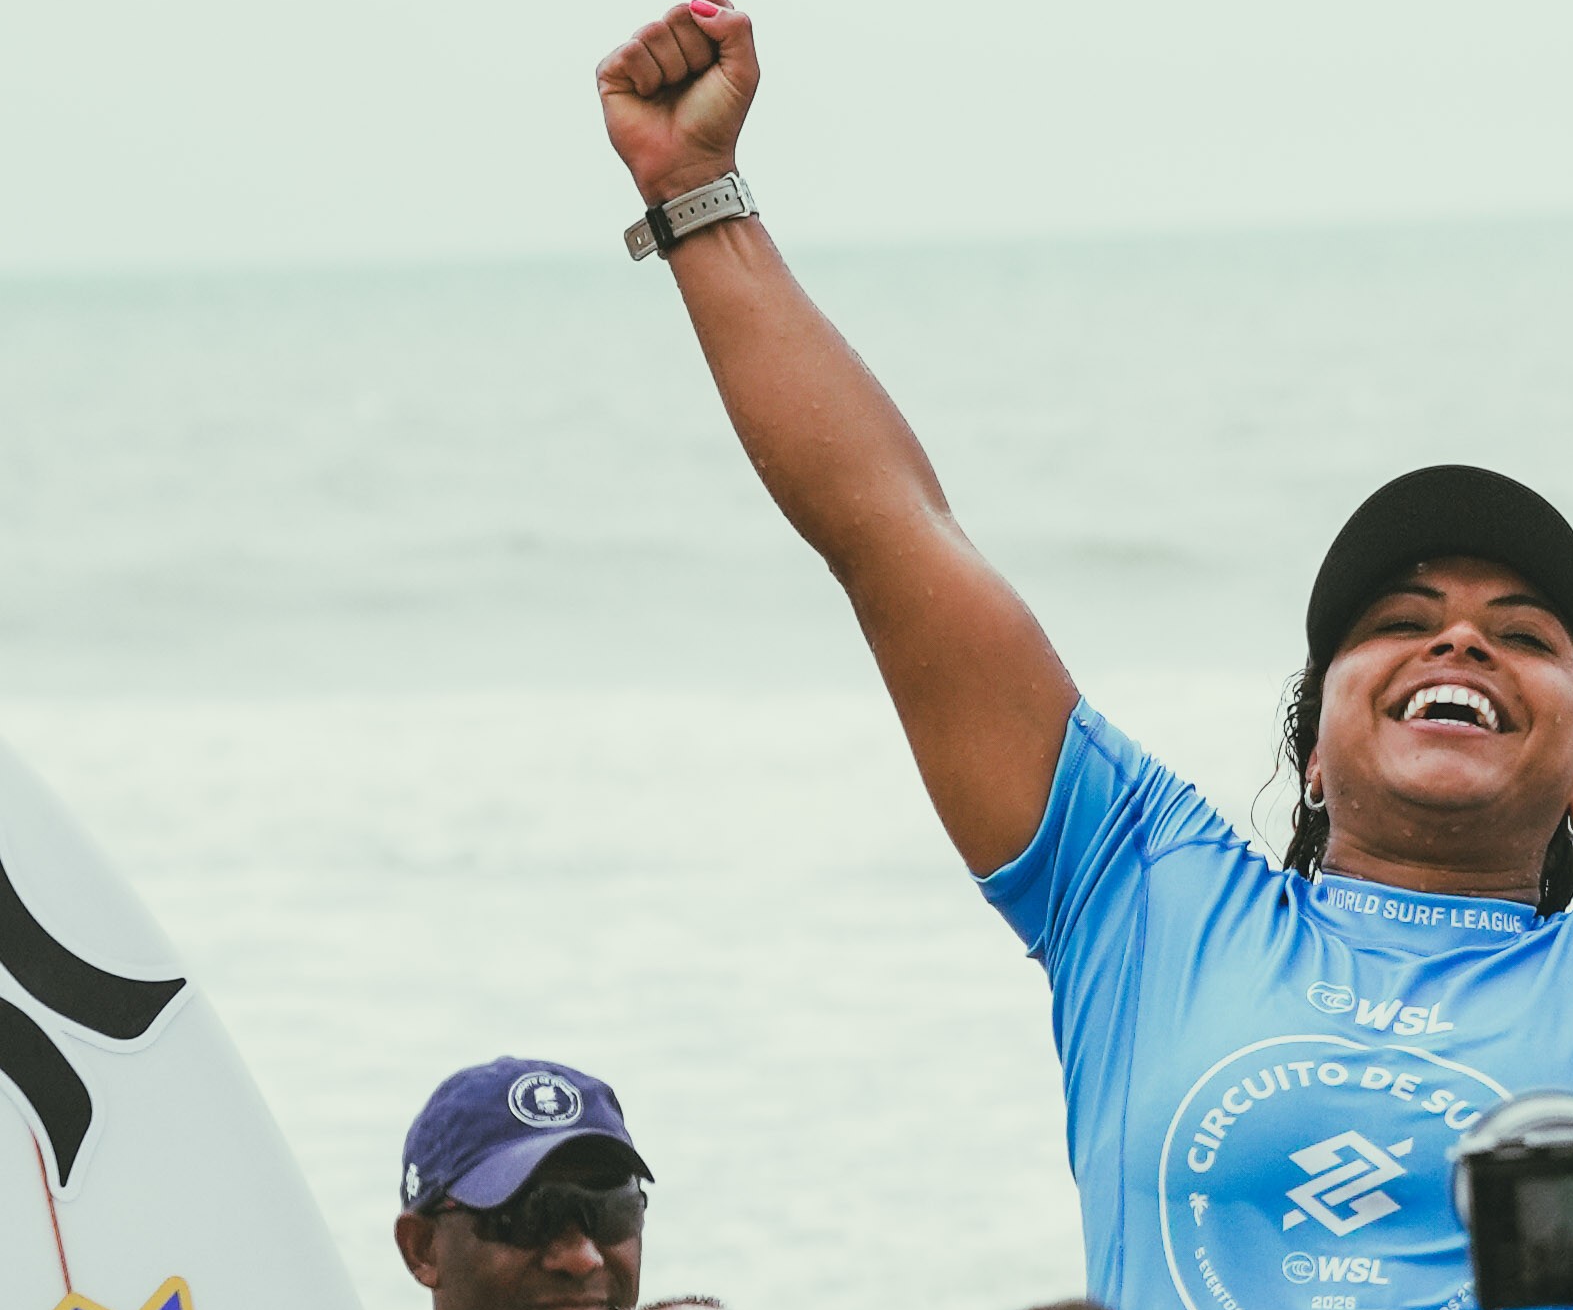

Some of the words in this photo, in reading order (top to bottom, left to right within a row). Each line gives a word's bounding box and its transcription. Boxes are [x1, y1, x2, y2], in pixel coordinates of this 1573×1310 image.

[1326, 886, 1380, 915] WORLD
[1382, 899, 1446, 927] SURF
[1450, 908, 1523, 934] LEAGUE
[1354, 996, 1455, 1037] WSL
[1186, 1059, 1348, 1175] CIRCUITO
[1359, 1064, 1424, 1104] DE
[1420, 1088, 1482, 1131] SU
[1316, 1255, 1392, 1286] WSL
[1310, 1295, 1357, 1310] 2026
